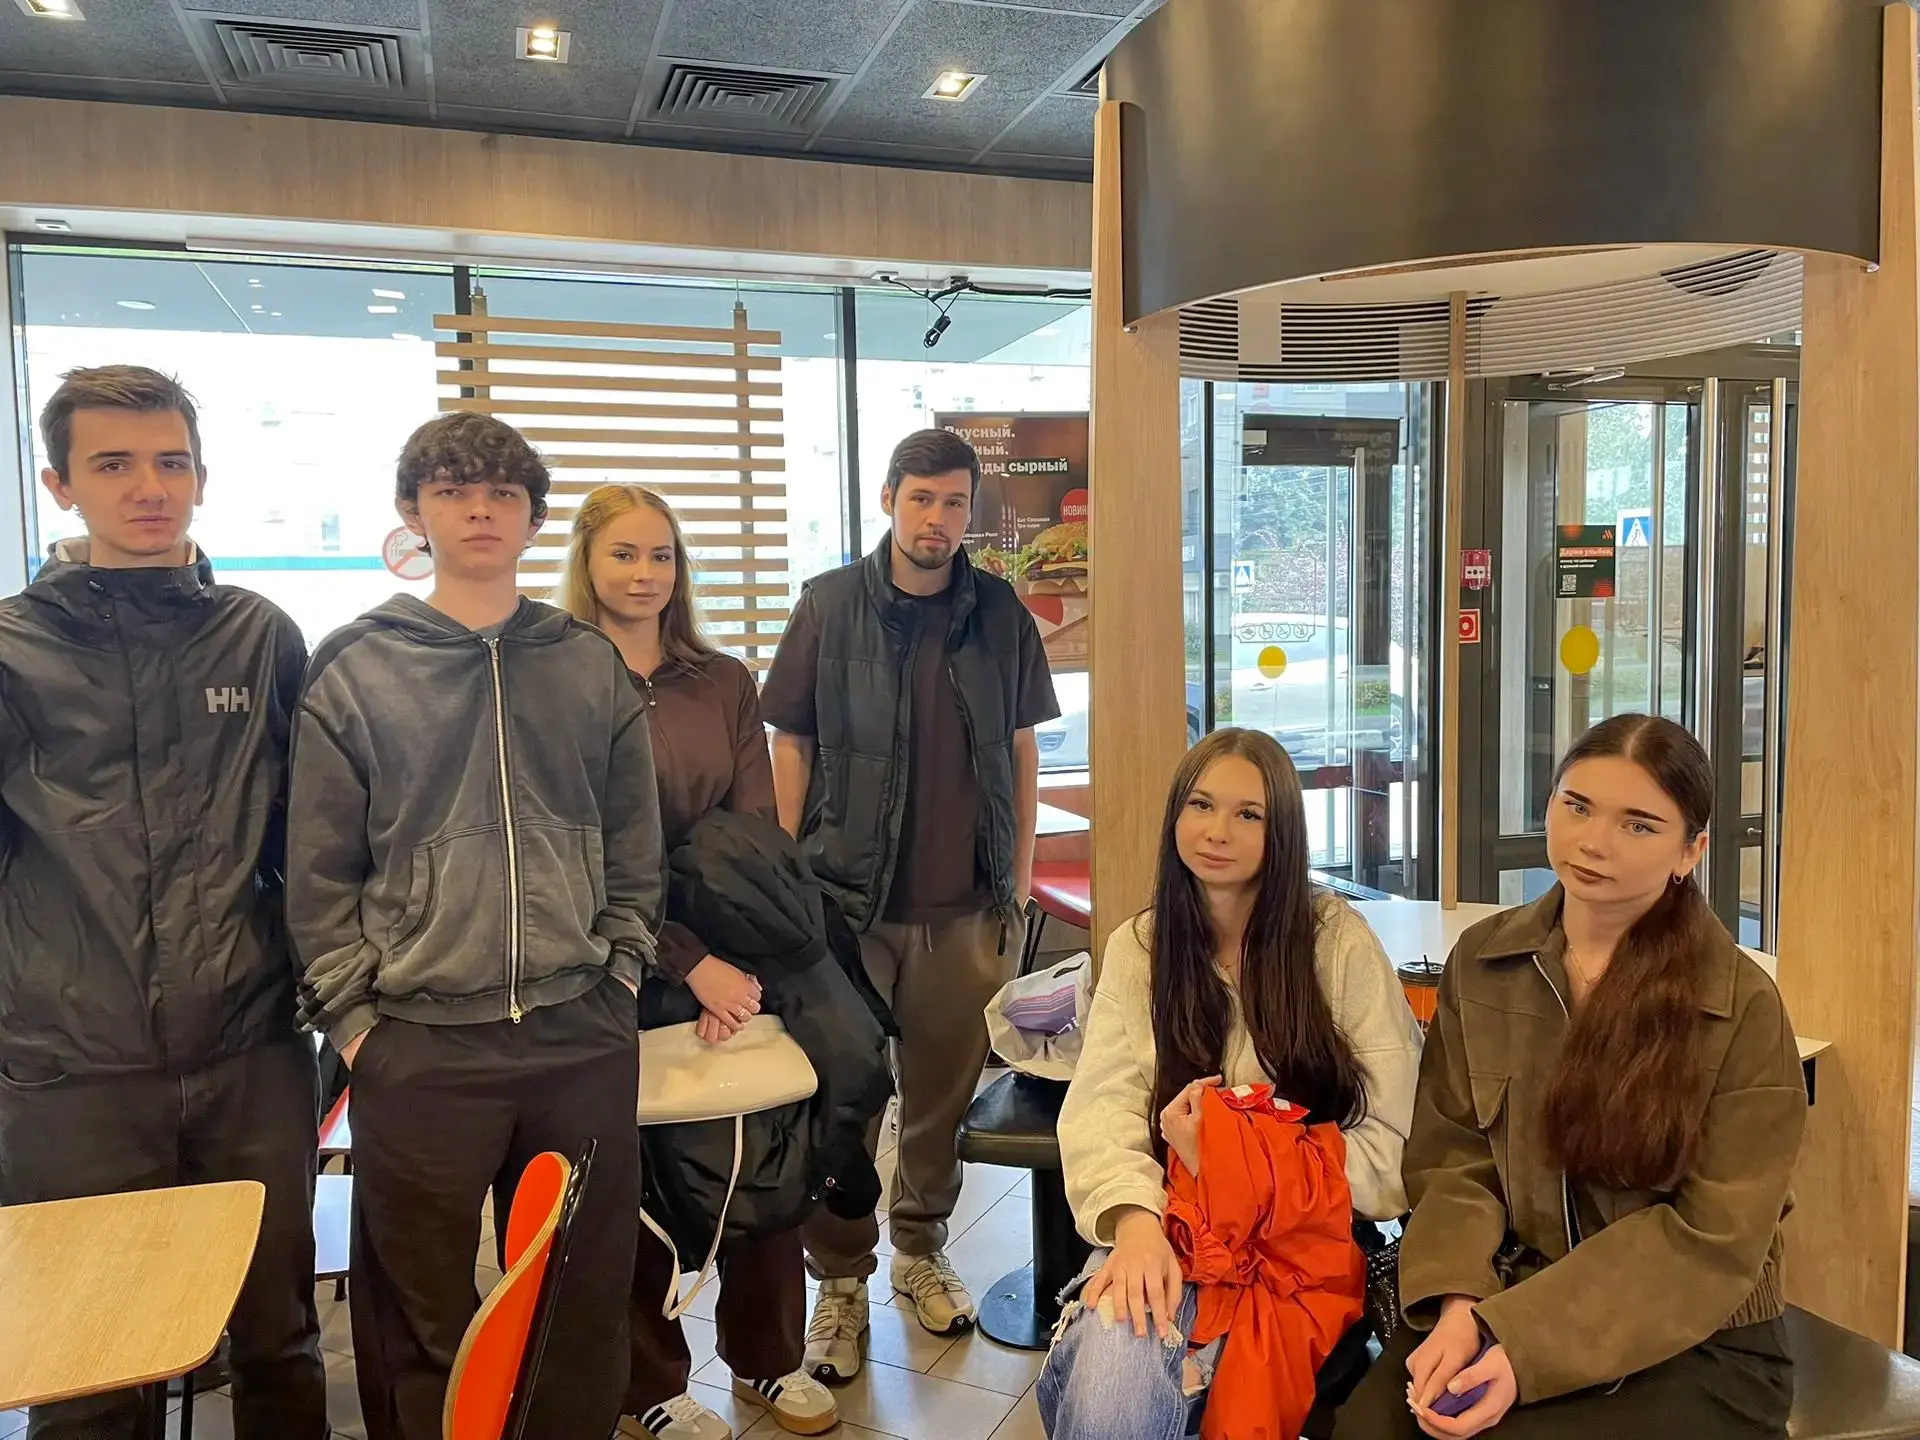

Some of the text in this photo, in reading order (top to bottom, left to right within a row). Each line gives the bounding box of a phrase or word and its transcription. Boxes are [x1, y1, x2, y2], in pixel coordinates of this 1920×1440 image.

[1008, 458, 1068, 474] сырный
[1063, 505, 1088, 517] НОВИН
[205, 686, 250, 713] HH
